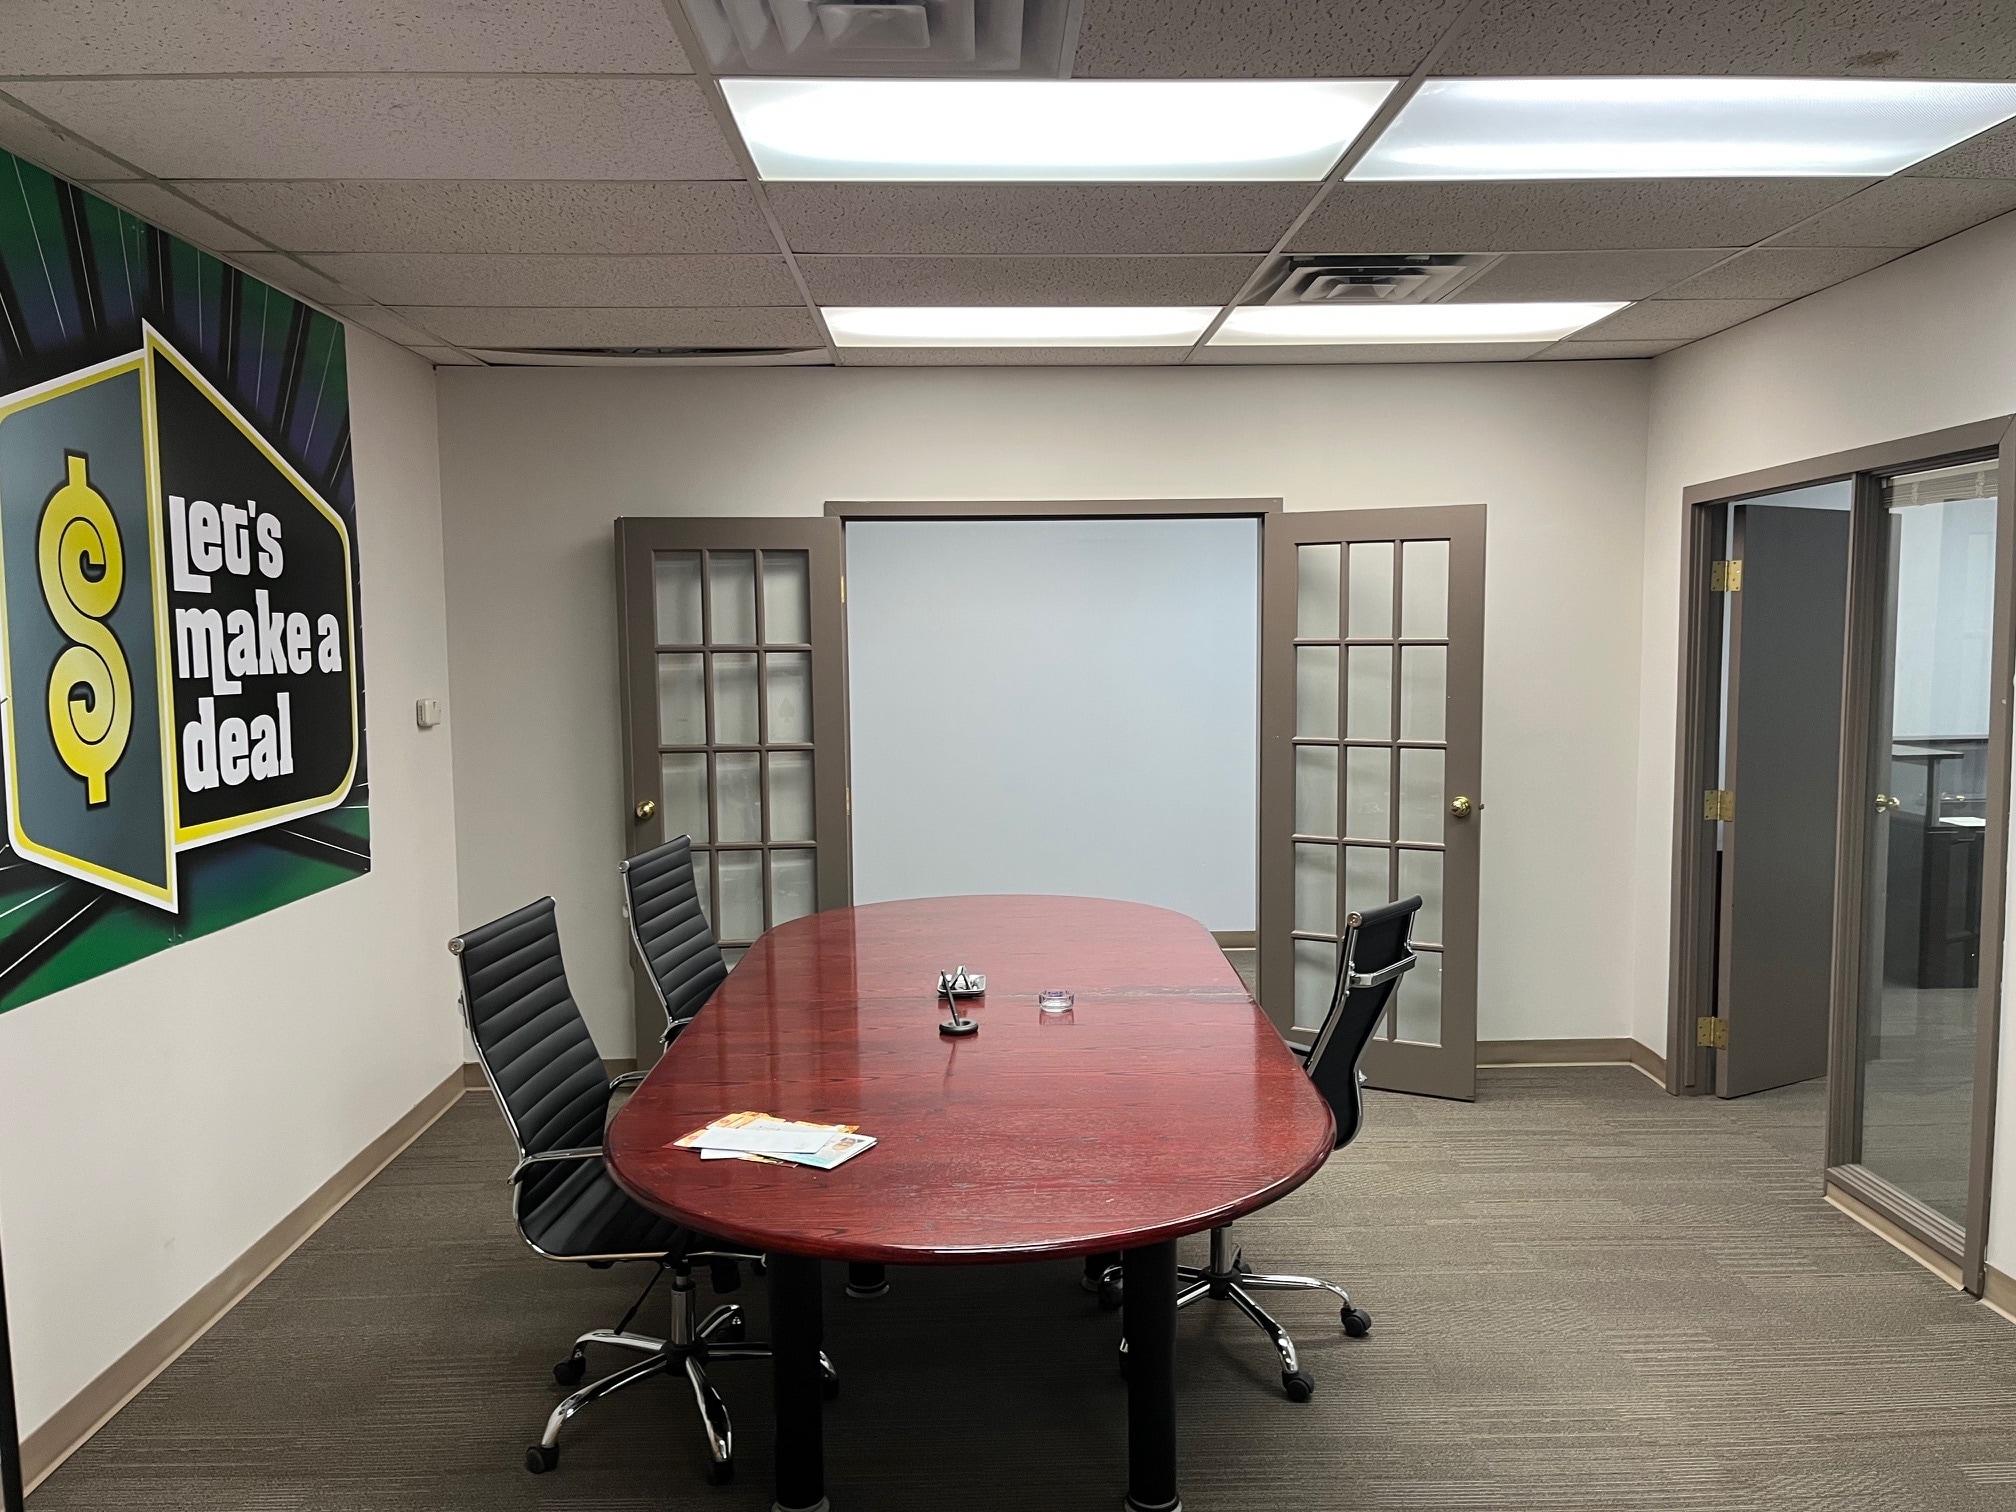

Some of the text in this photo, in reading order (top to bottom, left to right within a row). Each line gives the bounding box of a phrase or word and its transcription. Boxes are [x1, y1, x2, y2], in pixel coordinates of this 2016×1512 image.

[168, 494, 284, 594] Let's
[175, 588, 343, 696] make a
[182, 691, 294, 793] deal
